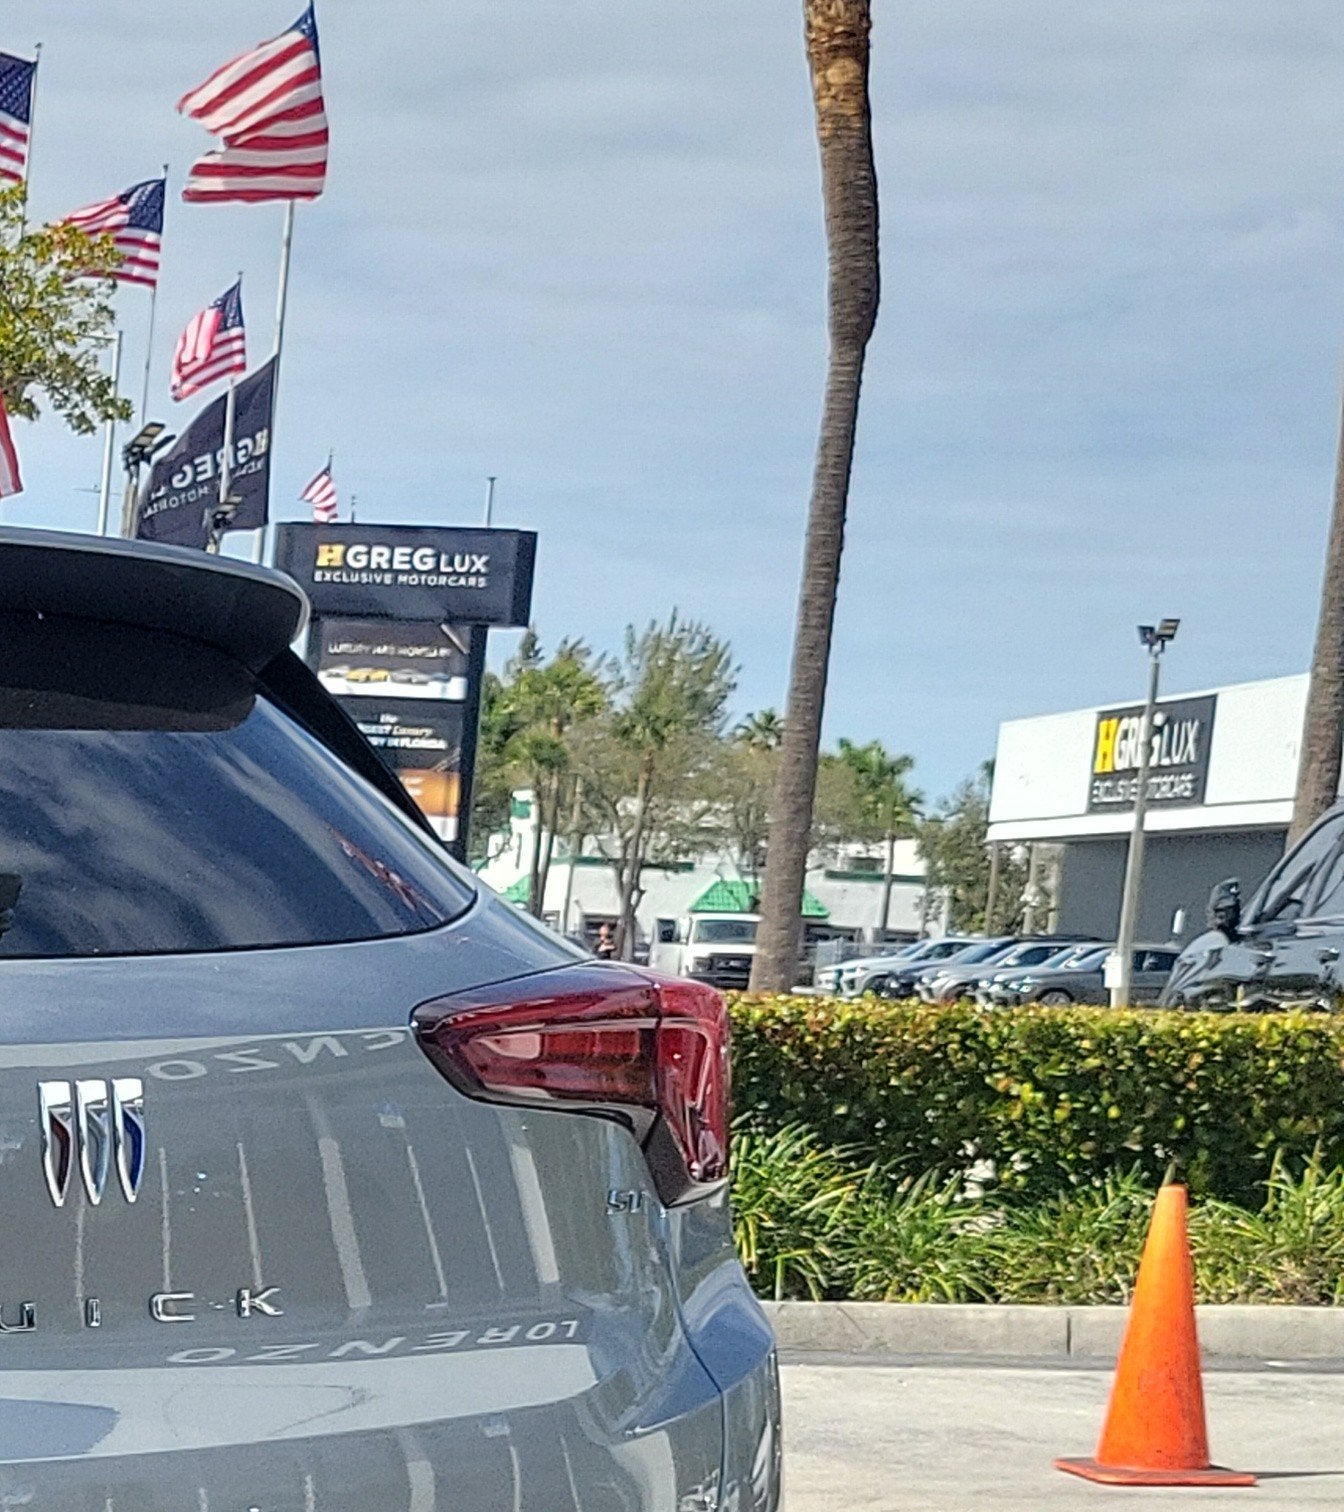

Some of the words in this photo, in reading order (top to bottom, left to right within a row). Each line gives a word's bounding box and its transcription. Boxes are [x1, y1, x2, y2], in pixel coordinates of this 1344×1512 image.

[314, 570, 393, 585] EXCLUSIVE
[397, 574, 488, 588] MOTORCARS
[439, 553, 490, 573] LUX
[1160, 719, 1199, 766] LUX
[165, 1318, 580, 1364] LORENZO
